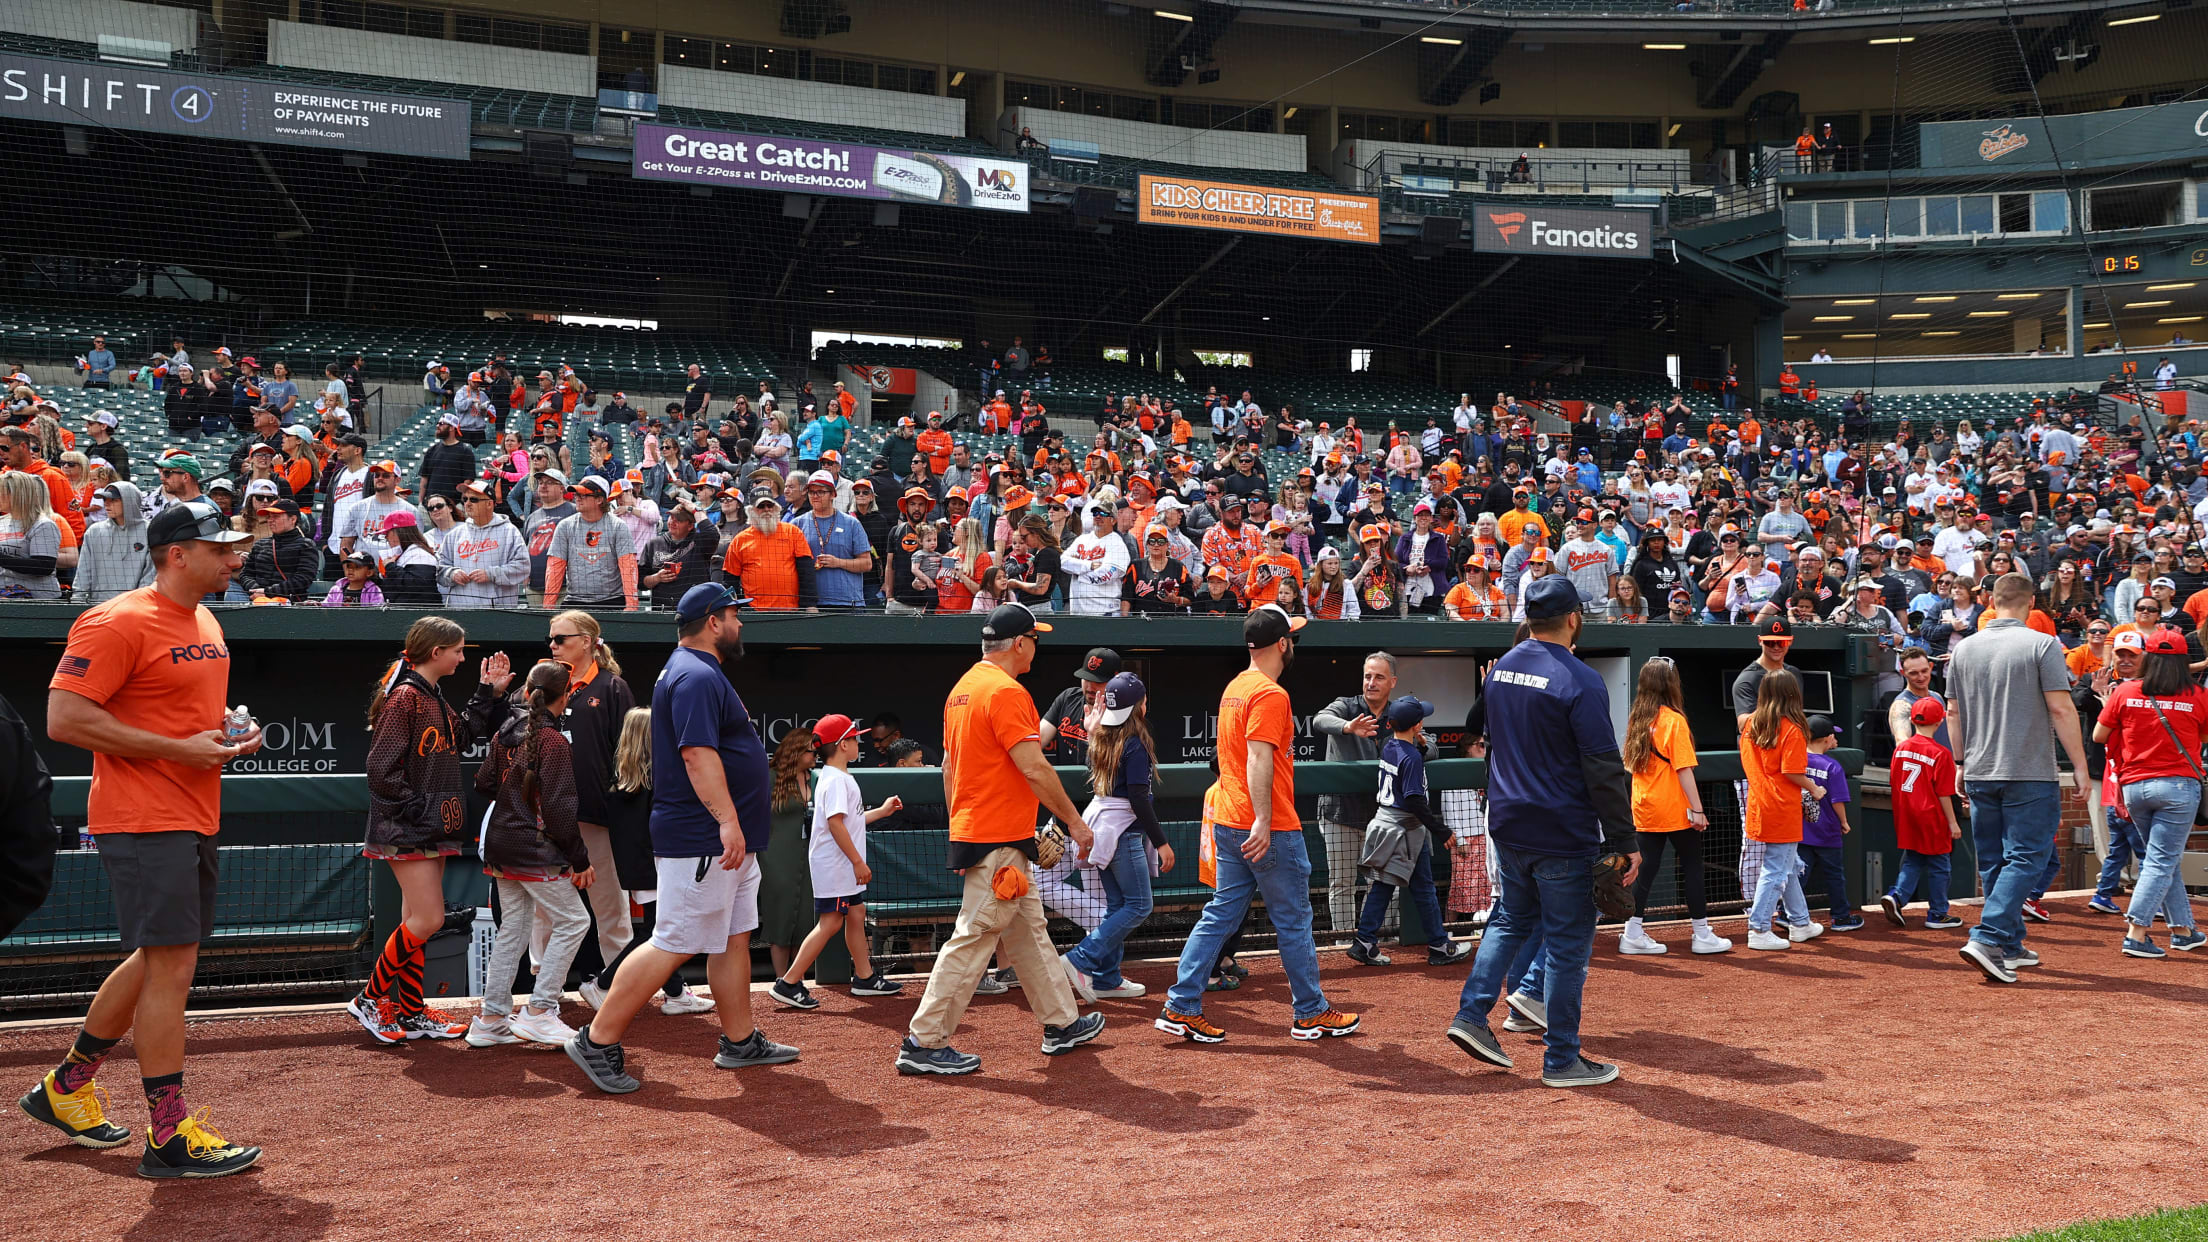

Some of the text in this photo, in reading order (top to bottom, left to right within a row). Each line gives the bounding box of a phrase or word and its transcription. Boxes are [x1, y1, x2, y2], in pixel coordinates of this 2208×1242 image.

[3, 69, 198, 116] SHIFT 4
[274, 92, 442, 118] EXPERIENCE THE FUTURE
[274, 107, 370, 127] OF PAYMENTS
[275, 126, 345, 139] www.shift4.com
[665, 134, 850, 172] Great Catch!
[642, 161, 867, 190] Get Your E-ZPass at DriveEzMD.COM
[977, 167, 1016, 189] MD
[974, 189, 1021, 201] DriveEzMD
[1151, 182, 1315, 221] KIDS CHEER FREE
[1150, 208, 1176, 218] BRING
[1177, 211, 1199, 220] YOUR
[1201, 213, 1221, 222] KIDS
[1228, 215, 1246, 224] AND
[1247, 217, 1275, 227] UNDER
[1276, 220, 1292, 229] FOR
[1293, 221, 1316, 231] FREE!
[1532, 221, 1639, 250] Fanatics
[2104, 255, 2140, 272] 0:15
[457, 538, 499, 558] Orioles
[1568, 550, 1609, 570] Orioles
[170, 643, 229, 665] ROGU
[1182, 746, 1212, 757] LAKE
[1299, 745, 1315, 756] OF
[232, 759, 310, 772] COLLEGE
[314, 759, 337, 772] OF
[1901, 761, 1922, 793] 7
[441, 796, 462, 834] 99
